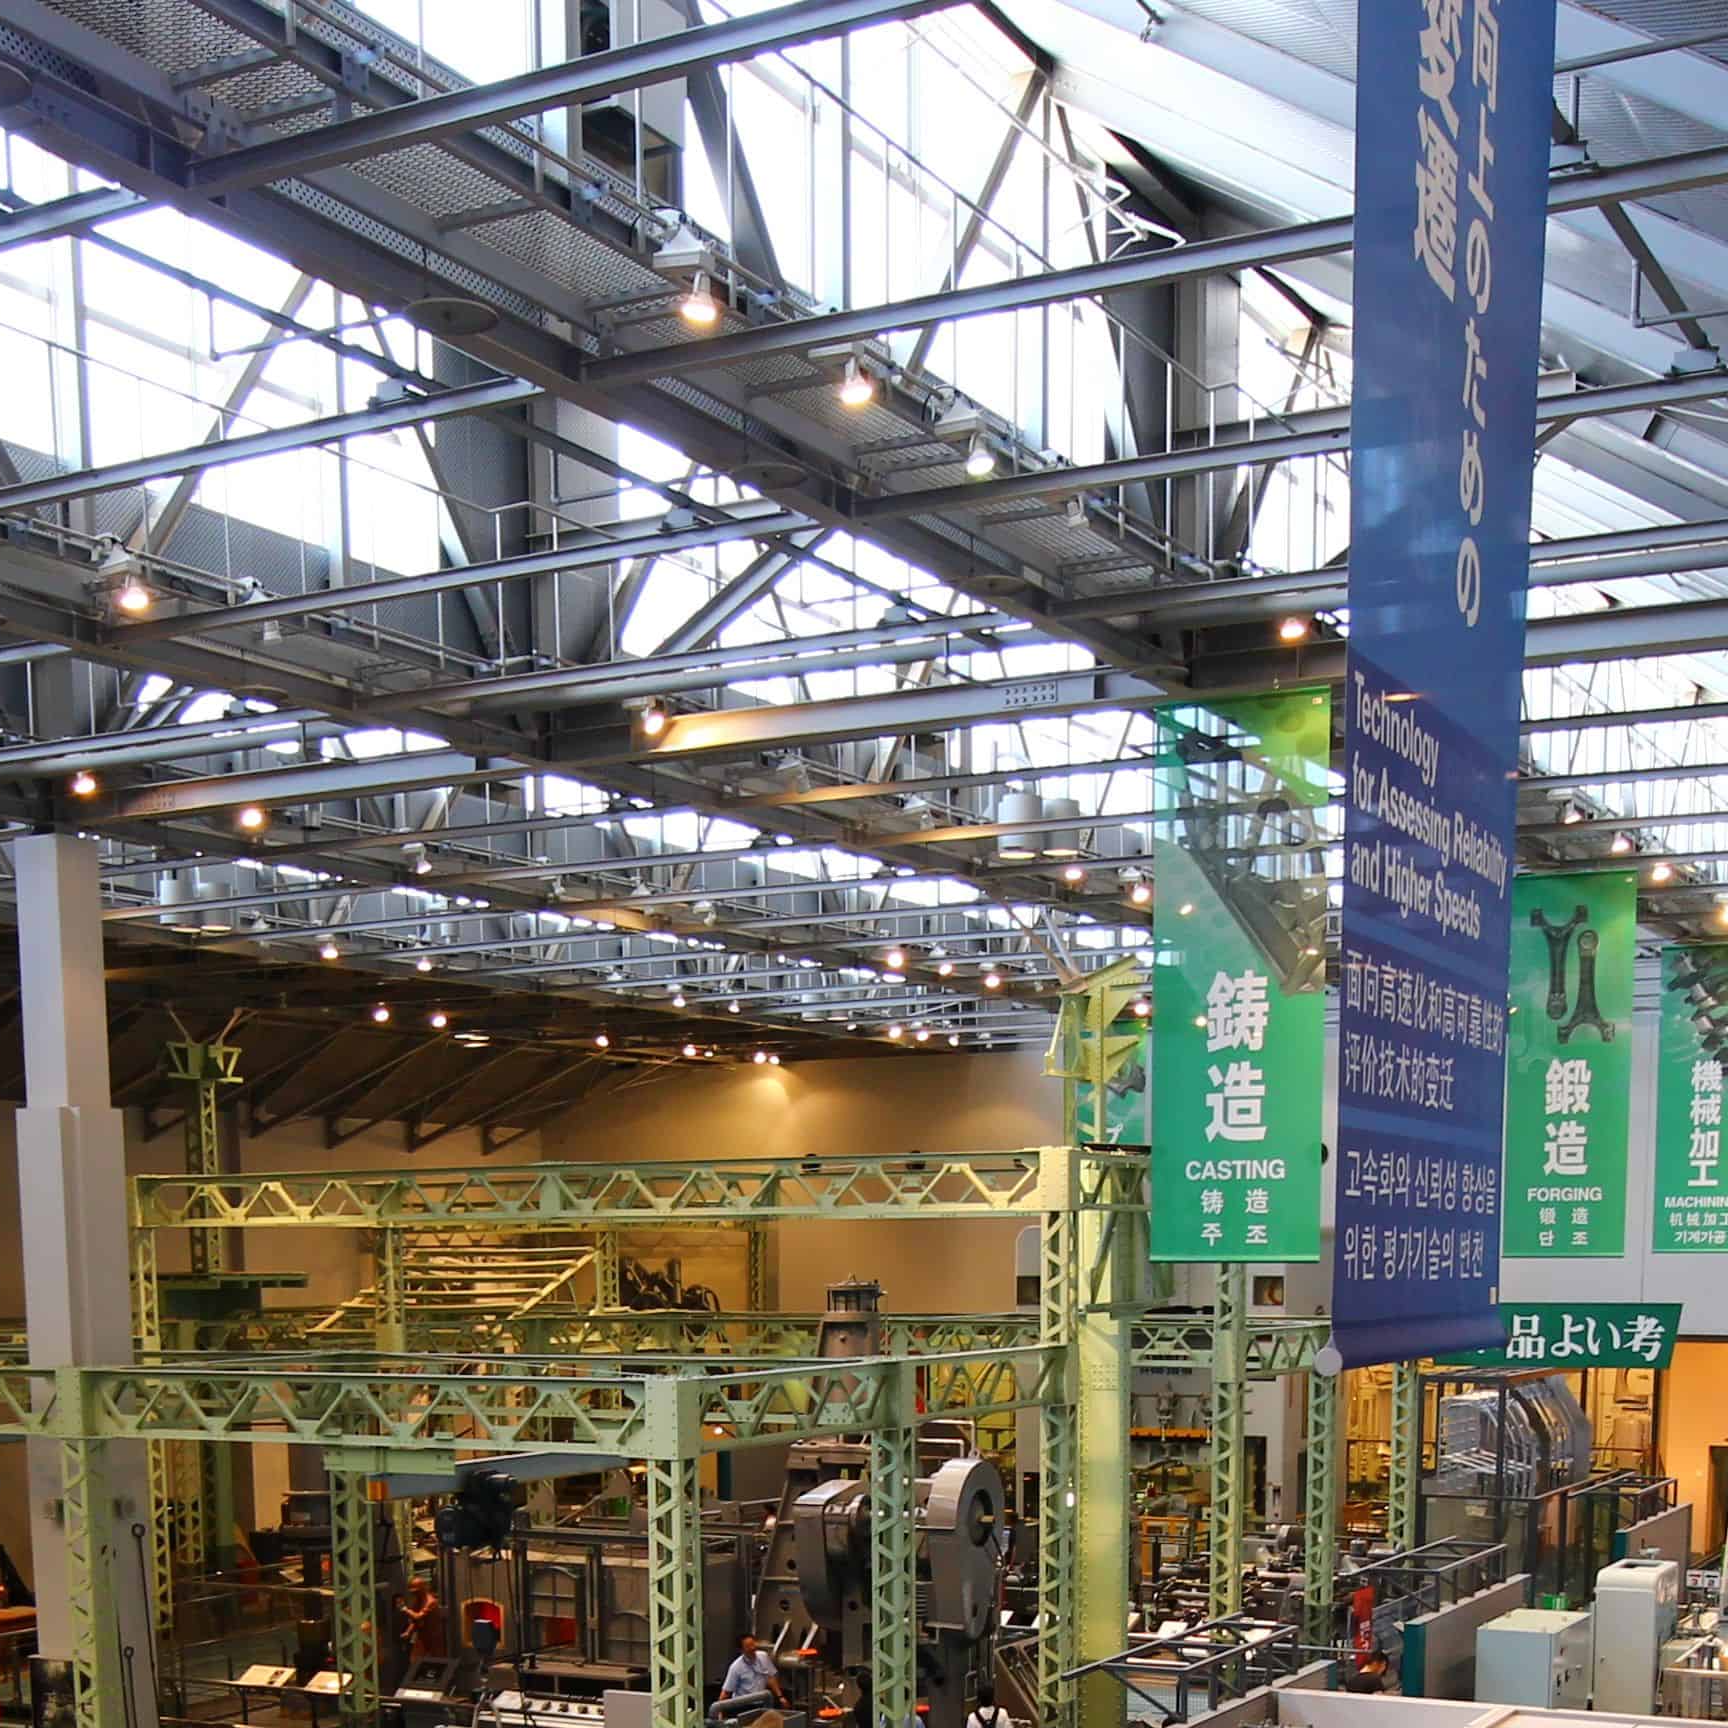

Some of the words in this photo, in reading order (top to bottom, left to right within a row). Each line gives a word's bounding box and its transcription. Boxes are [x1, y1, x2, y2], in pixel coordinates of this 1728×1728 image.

[1354, 670, 1440, 788] Technology
[1352, 751, 1376, 814] for
[1377, 767, 1450, 868] Assessing
[1453, 811, 1508, 899] Reliability
[1351, 840, 1381, 894] and
[1384, 845, 1433, 919] Higher
[1434, 871, 1481, 940] Speeds
[1345, 1031, 1455, 1111] 评价技术的变迁
[1543, 1058, 1592, 1176] 鍛造
[1687, 1059, 1723, 1187] 機械加工
[1185, 1158, 1286, 1181] CASTING
[1345, 1148, 1410, 1209] 고속화와
[1415, 1157, 1457, 1212] 신뢰성
[1461, 1163, 1496, 1216] 향상을
[1527, 1186, 1603, 1203] FORGING
[1343, 1223, 1378, 1281] 위한
[1383, 1225, 1455, 1281] 평가기술의
[1459, 1229, 1485, 1280] 변천
[1477, 1314, 1666, 1362] 品よい考
